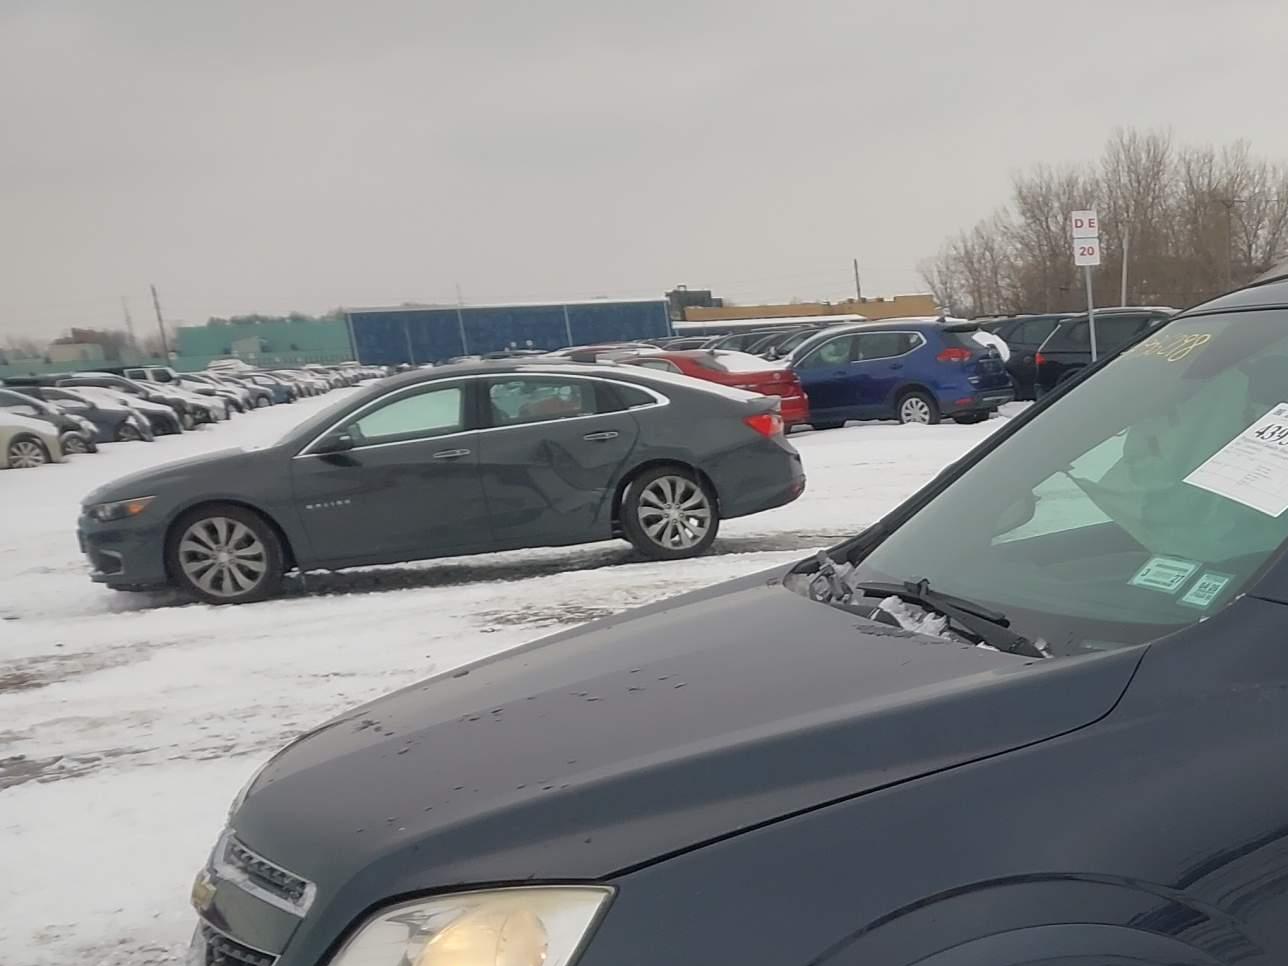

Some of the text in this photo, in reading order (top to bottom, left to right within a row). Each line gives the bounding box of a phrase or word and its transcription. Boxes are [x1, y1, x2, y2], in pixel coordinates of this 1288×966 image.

[1074, 218, 1096, 229] D E
[1079, 246, 1095, 257] 20
